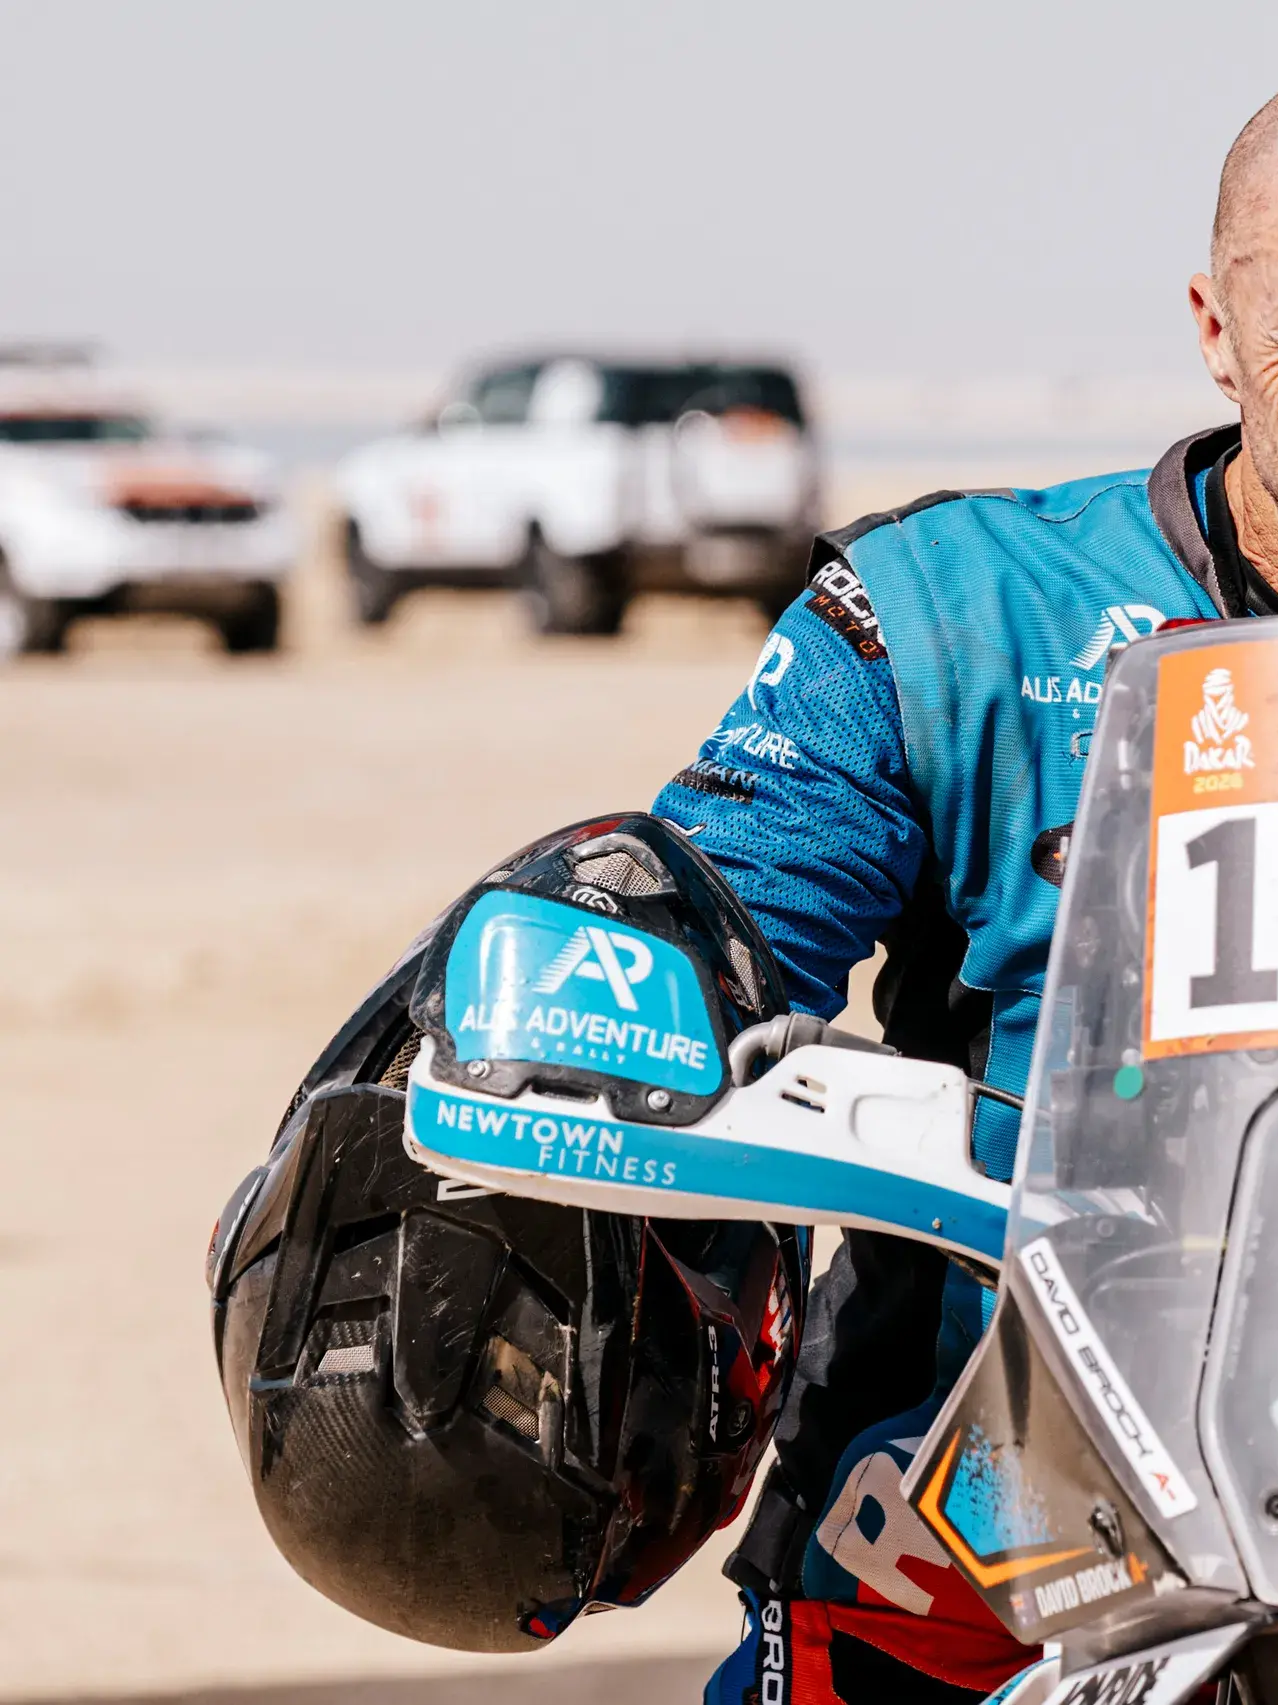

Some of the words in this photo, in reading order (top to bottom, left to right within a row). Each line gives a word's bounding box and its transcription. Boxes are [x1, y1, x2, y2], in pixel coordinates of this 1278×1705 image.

[814, 595, 878, 654] MOTO
[525, 1006, 708, 1071] ADVENTURE
[556, 1041, 627, 1065] RALLY
[437, 1101, 624, 1154] NEWTOWN
[538, 1146, 677, 1185] FITNESS
[707, 1325, 721, 1443] ATR-3
[1030, 1251, 1080, 1335] DAVID
[1077, 1345, 1153, 1459] BROCK
[1034, 1576, 1080, 1619] DAVID
[1075, 1558, 1133, 1604] BROCK
